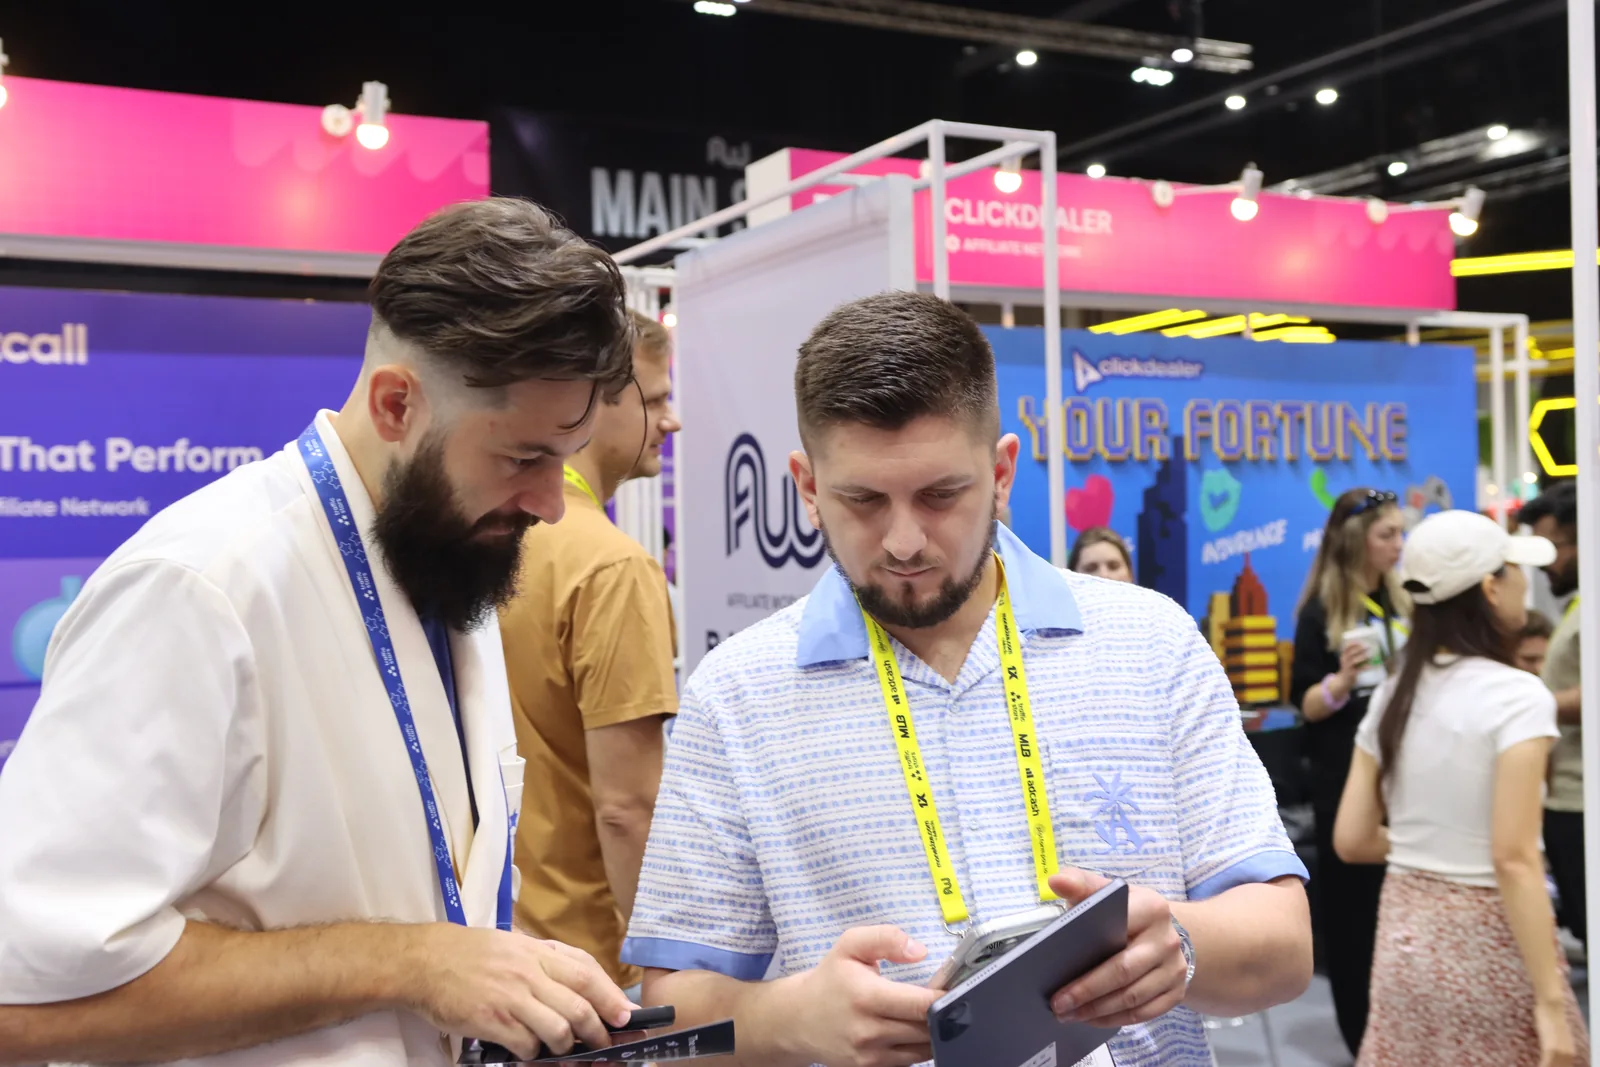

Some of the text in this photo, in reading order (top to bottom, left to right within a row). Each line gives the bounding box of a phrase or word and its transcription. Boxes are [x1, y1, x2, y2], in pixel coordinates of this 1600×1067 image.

[590, 167, 719, 238] MAIN
[944, 198, 1112, 234] CLICKDALER
[0, 323, 88, 365] call
[1098, 357, 1203, 378] clickdealer
[1018, 396, 1407, 462] YOUR FORTUNE
[0, 436, 264, 472] That Perform
[61, 497, 149, 516] Network
[329, 497, 340, 516] traffic
[336, 498, 346, 514] stars
[883, 660, 897, 693] adcash
[1018, 703, 1026, 722] traffic
[896, 714, 910, 739] MLB
[1018, 734, 1031, 758] MLB
[904, 750, 913, 769] traffic
[911, 752, 919, 769] stars
[1027, 780, 1040, 816] adcash
